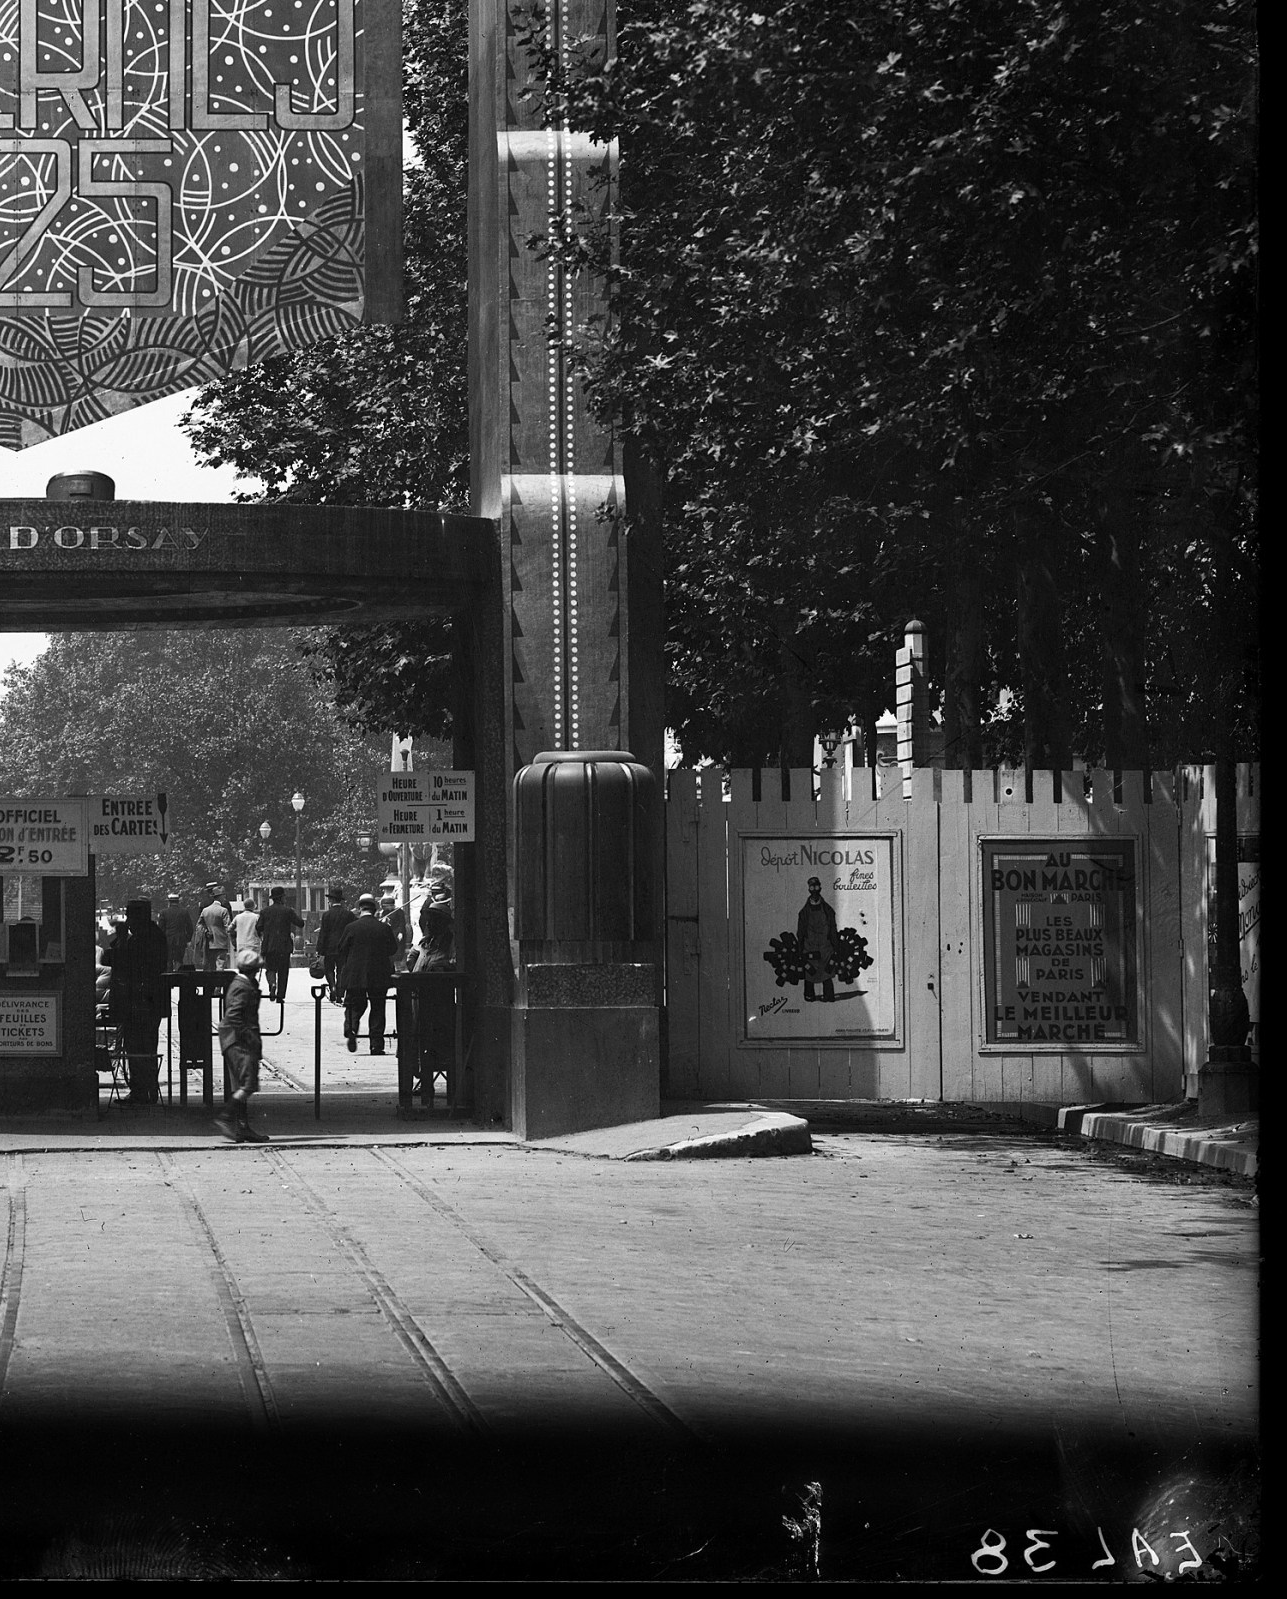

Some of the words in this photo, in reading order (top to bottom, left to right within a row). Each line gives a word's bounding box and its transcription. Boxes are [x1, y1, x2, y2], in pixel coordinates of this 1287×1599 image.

[9, 526, 209, 550] D'ORSAY
[433, 776, 443, 788] 10
[431, 791, 440, 801] du
[441, 789, 467, 801] MATIN
[102, 798, 153, 816] ENTRÉE
[436, 809, 442, 821] 1
[94, 824, 110, 836] DES
[432, 824, 441, 833] du
[442, 822, 467, 833] MATIN
[799, 845, 874, 866] NICOLAS
[1045, 852, 1071, 867] AU
[991, 869, 1036, 890] BON
[1071, 893, 1101, 902] PARIS
[1046, 916, 1073, 927] LES
[1016, 928, 1051, 941] PLUS
[1056, 928, 1102, 941] BEAUX
[1016, 943, 1103, 956] MAGASINS
[1052, 958, 1069, 967] DE
[1036, 968, 1084, 980] PARIS
[1018, 991, 1103, 1003] VENDANT
[0, 1014, 46, 1023] FEUILLES
[994, 1006, 1015, 1021] LE
[1024, 1006, 1128, 1021] MEILLEUR
[1, 1027, 45, 1037] TICKETS
[1018, 1021, 1106, 1040] MARCHÉ
